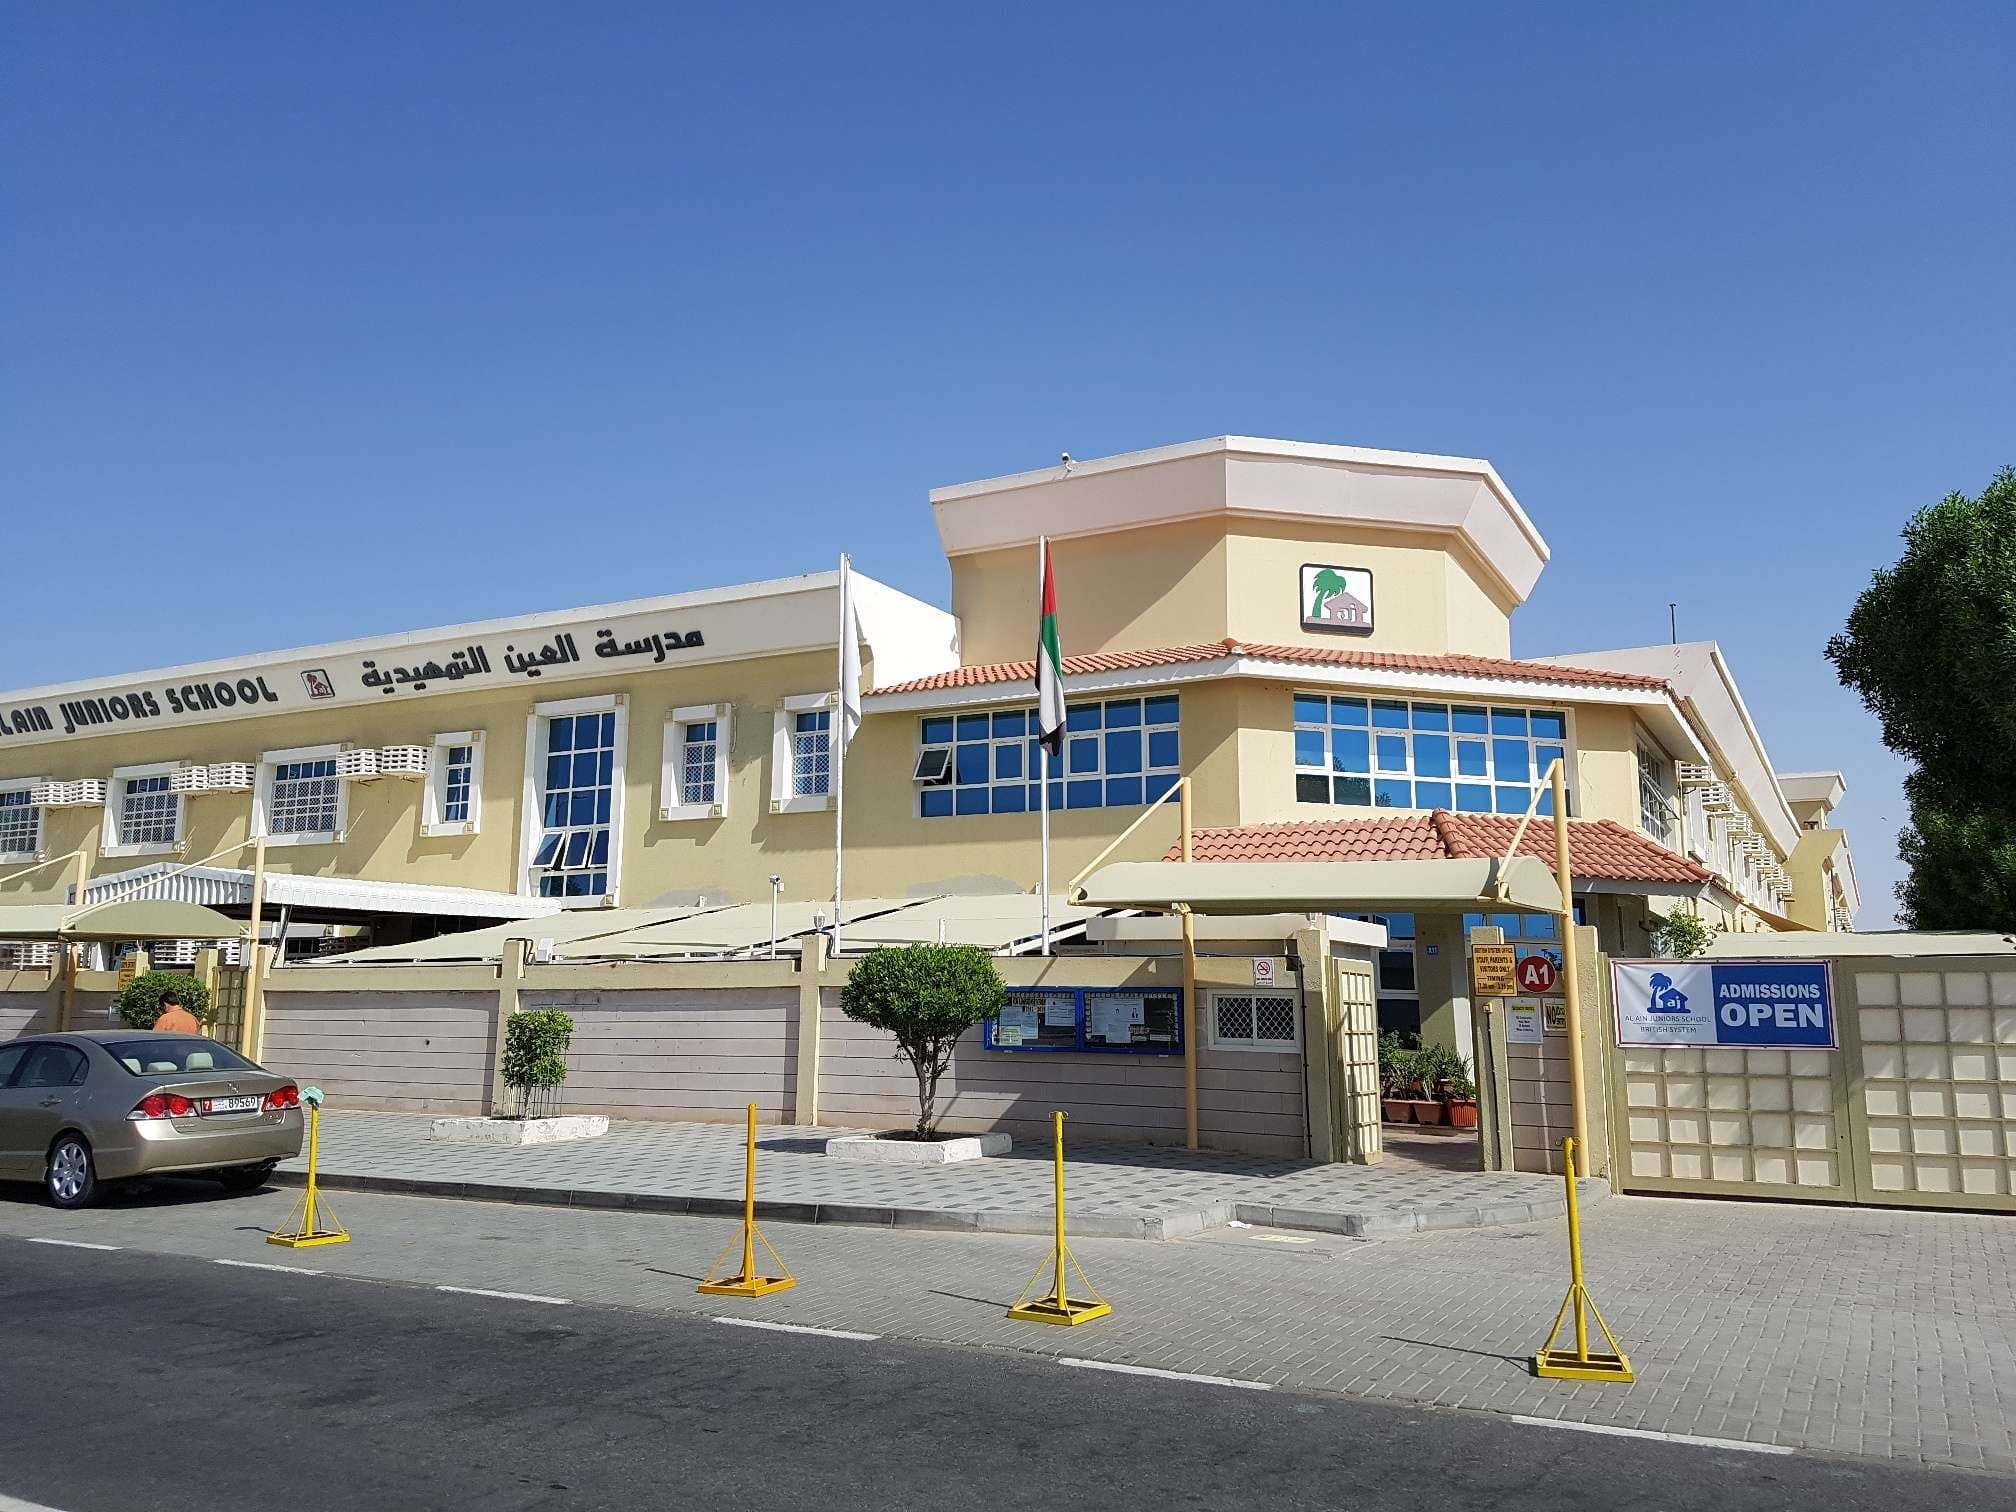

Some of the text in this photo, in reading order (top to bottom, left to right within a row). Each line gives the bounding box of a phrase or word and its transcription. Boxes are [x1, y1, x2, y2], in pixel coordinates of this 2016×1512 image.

[361, 629, 705, 695] مدرسة العين التمهيدية
[59, 691, 161, 734] JUNIORS
[165, 676, 279, 714] SCHOOL
[1490, 956, 1508, 964] PARENTS
[1480, 965, 1510, 973] VISITORS ONLY
[1524, 964, 1550, 985] A1
[1719, 983, 1821, 999] ADMISSIONS
[1650, 1015, 1680, 1023] JUNIORS
[1681, 1015, 1712, 1023] SCHOOL
[1720, 1002, 1825, 1028] OPEN
[204, 1100, 210, 1110] 7
[228, 1096, 256, 1109] 89569
